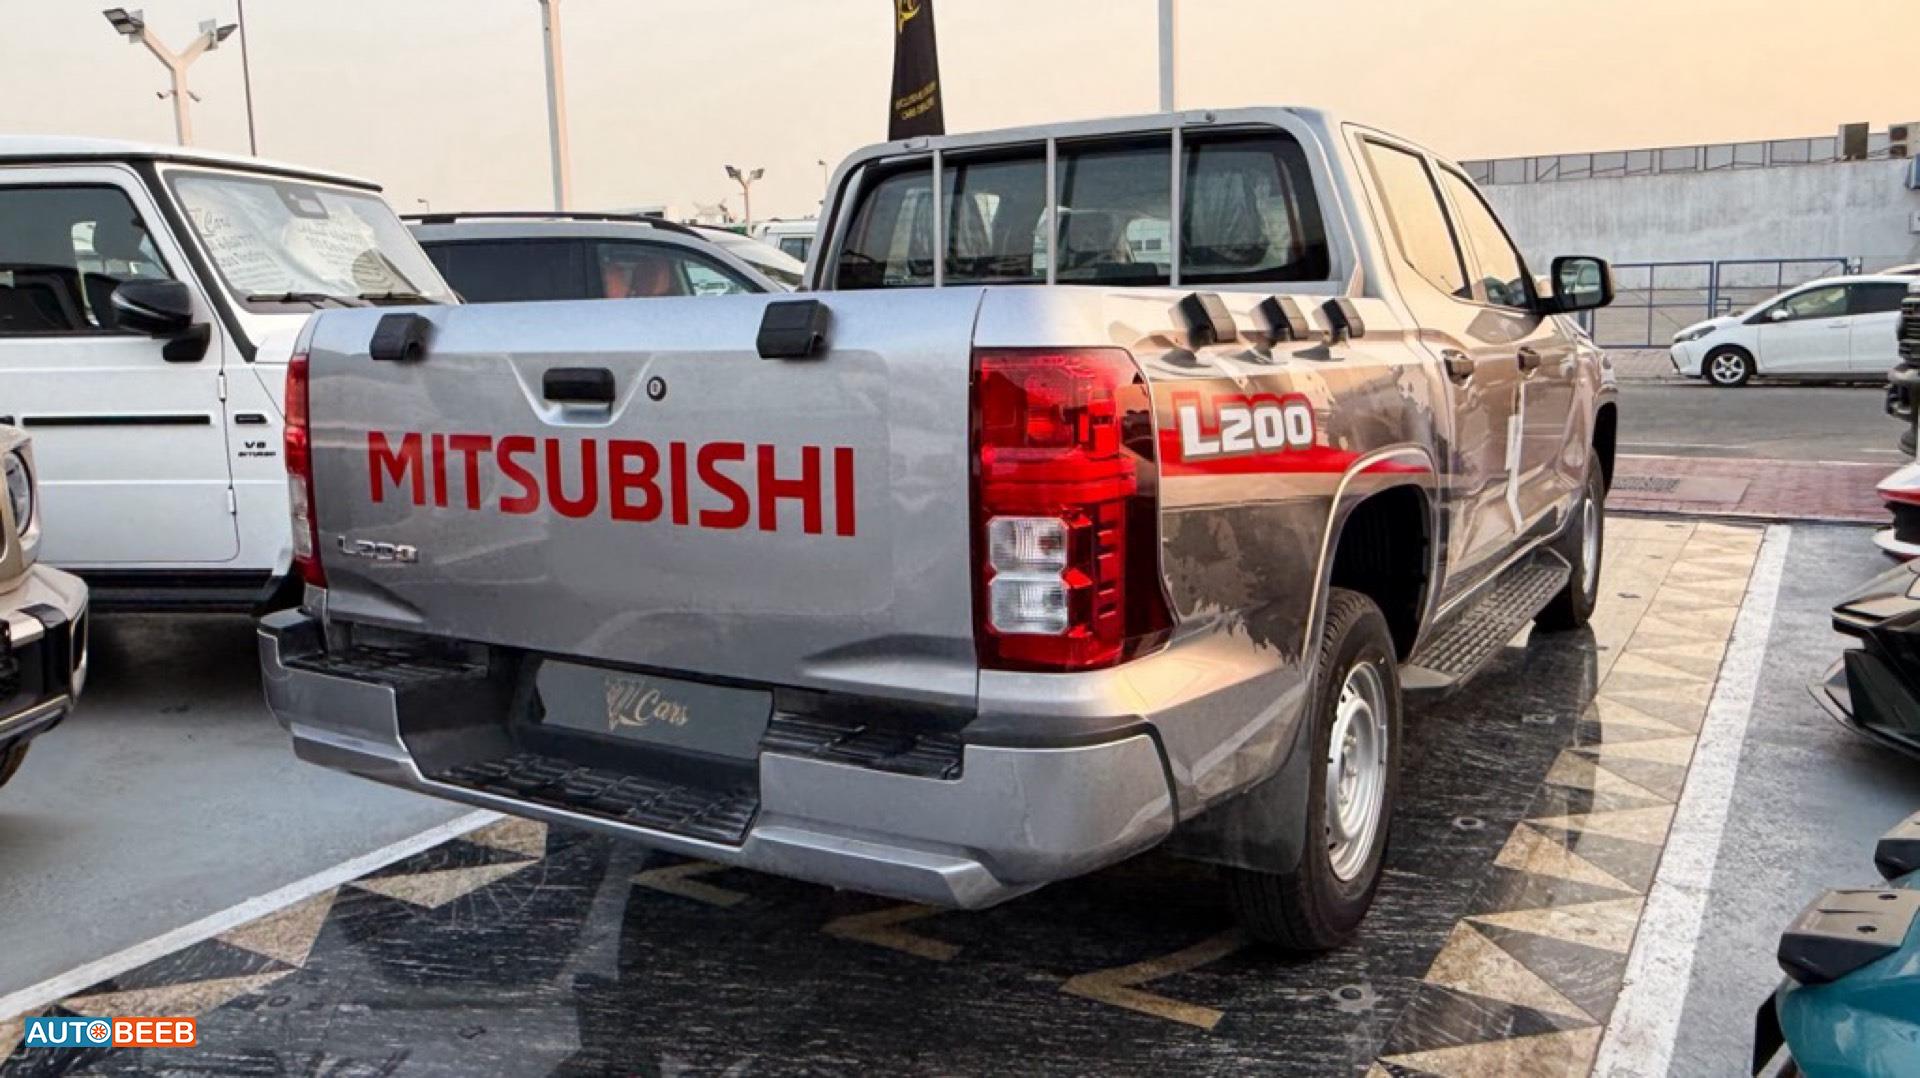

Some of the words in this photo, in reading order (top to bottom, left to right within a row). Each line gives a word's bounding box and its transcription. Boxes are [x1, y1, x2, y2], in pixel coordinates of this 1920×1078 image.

[1178, 403, 1314, 458] L200
[366, 429, 856, 538] MITSUBISHI
[635, 688, 689, 727] Cars
